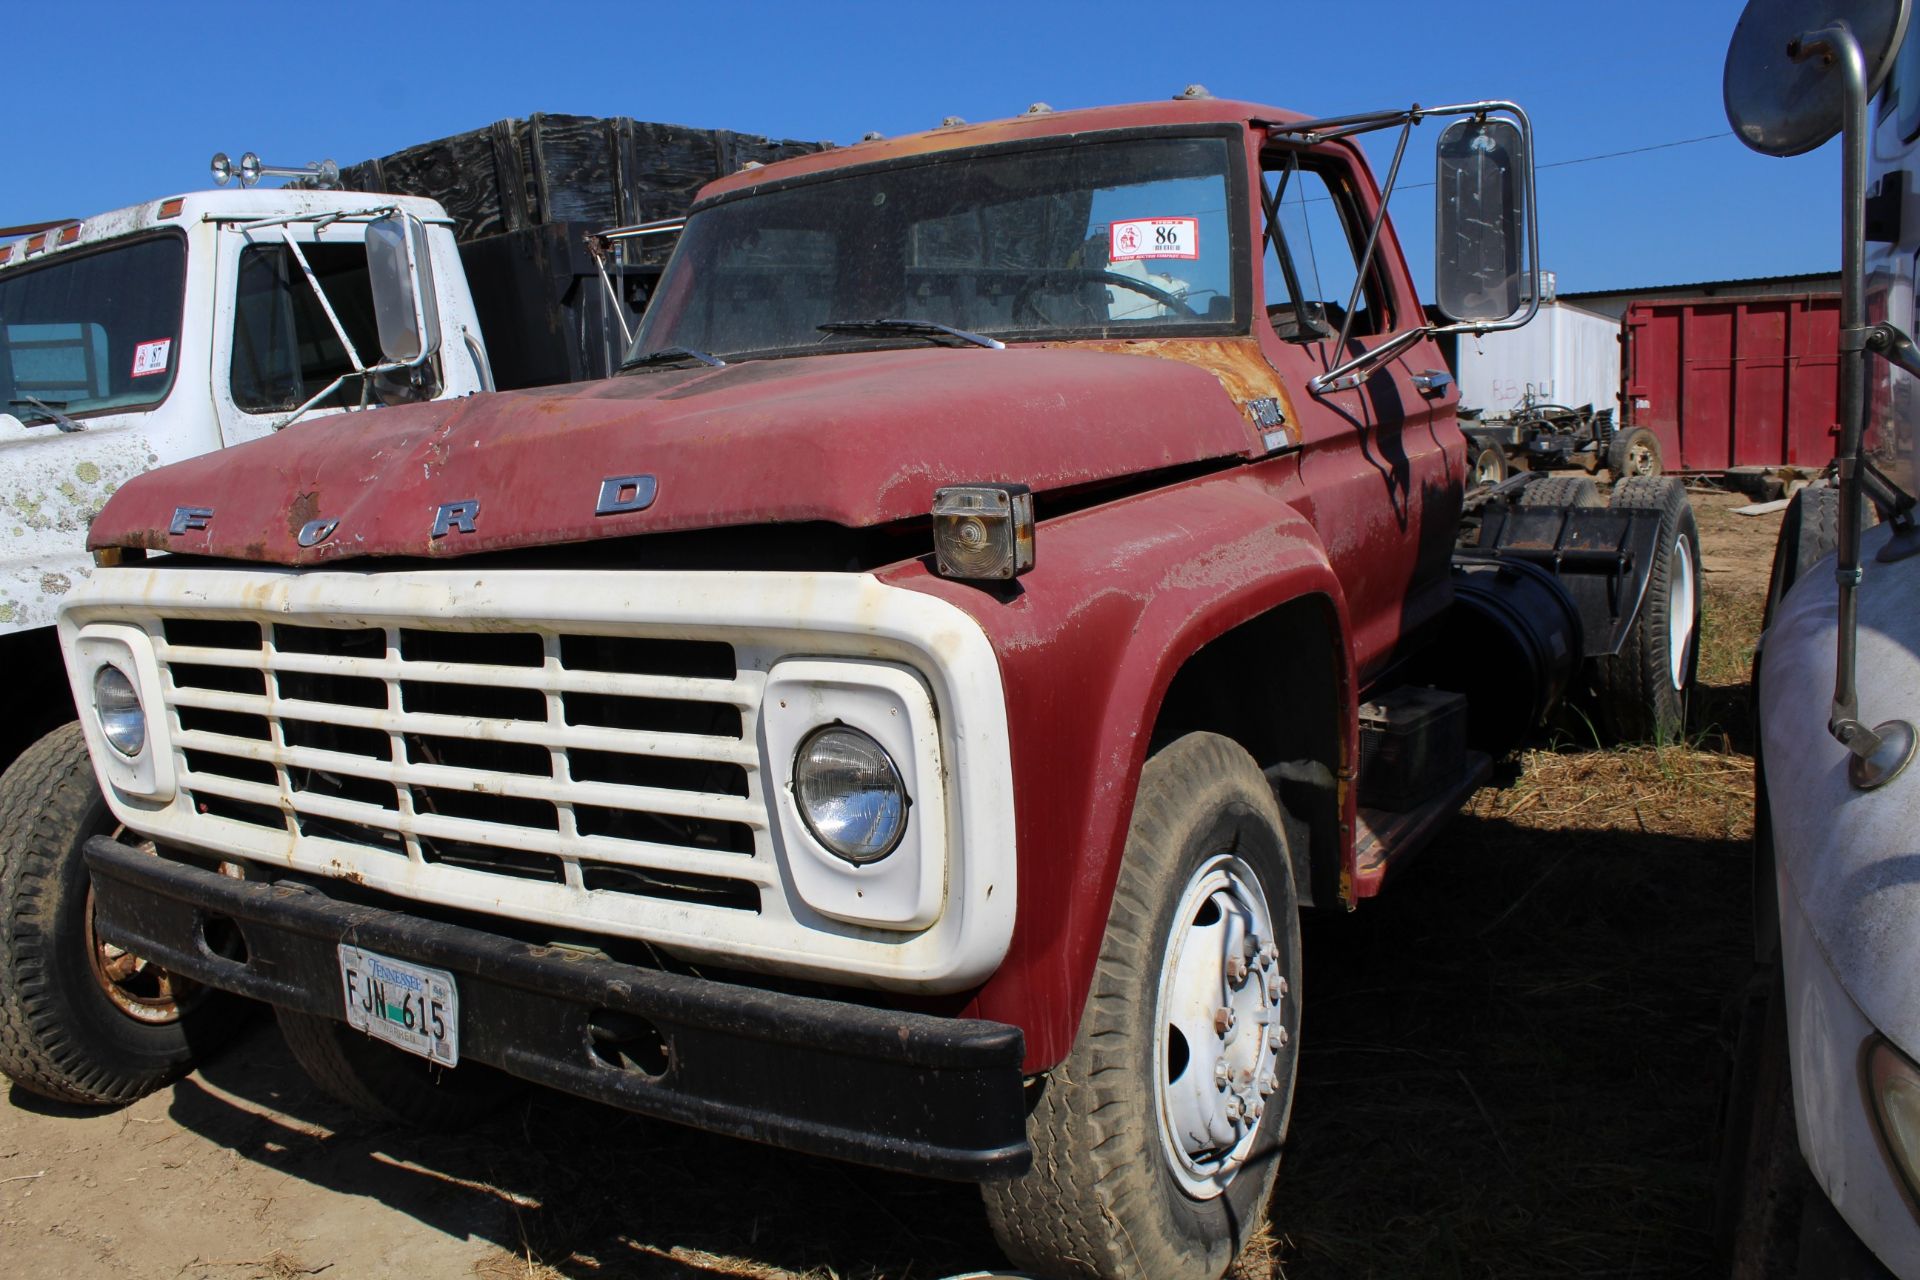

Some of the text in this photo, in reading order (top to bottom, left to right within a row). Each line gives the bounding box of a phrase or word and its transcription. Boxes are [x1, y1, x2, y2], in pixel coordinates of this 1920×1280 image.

[1156, 226, 1177, 245] 86
[152, 347, 162, 362] 87
[169, 474, 657, 548] FORD
[367, 958, 423, 992] TENNESSEE
[346, 968, 446, 1041] FJN 615
